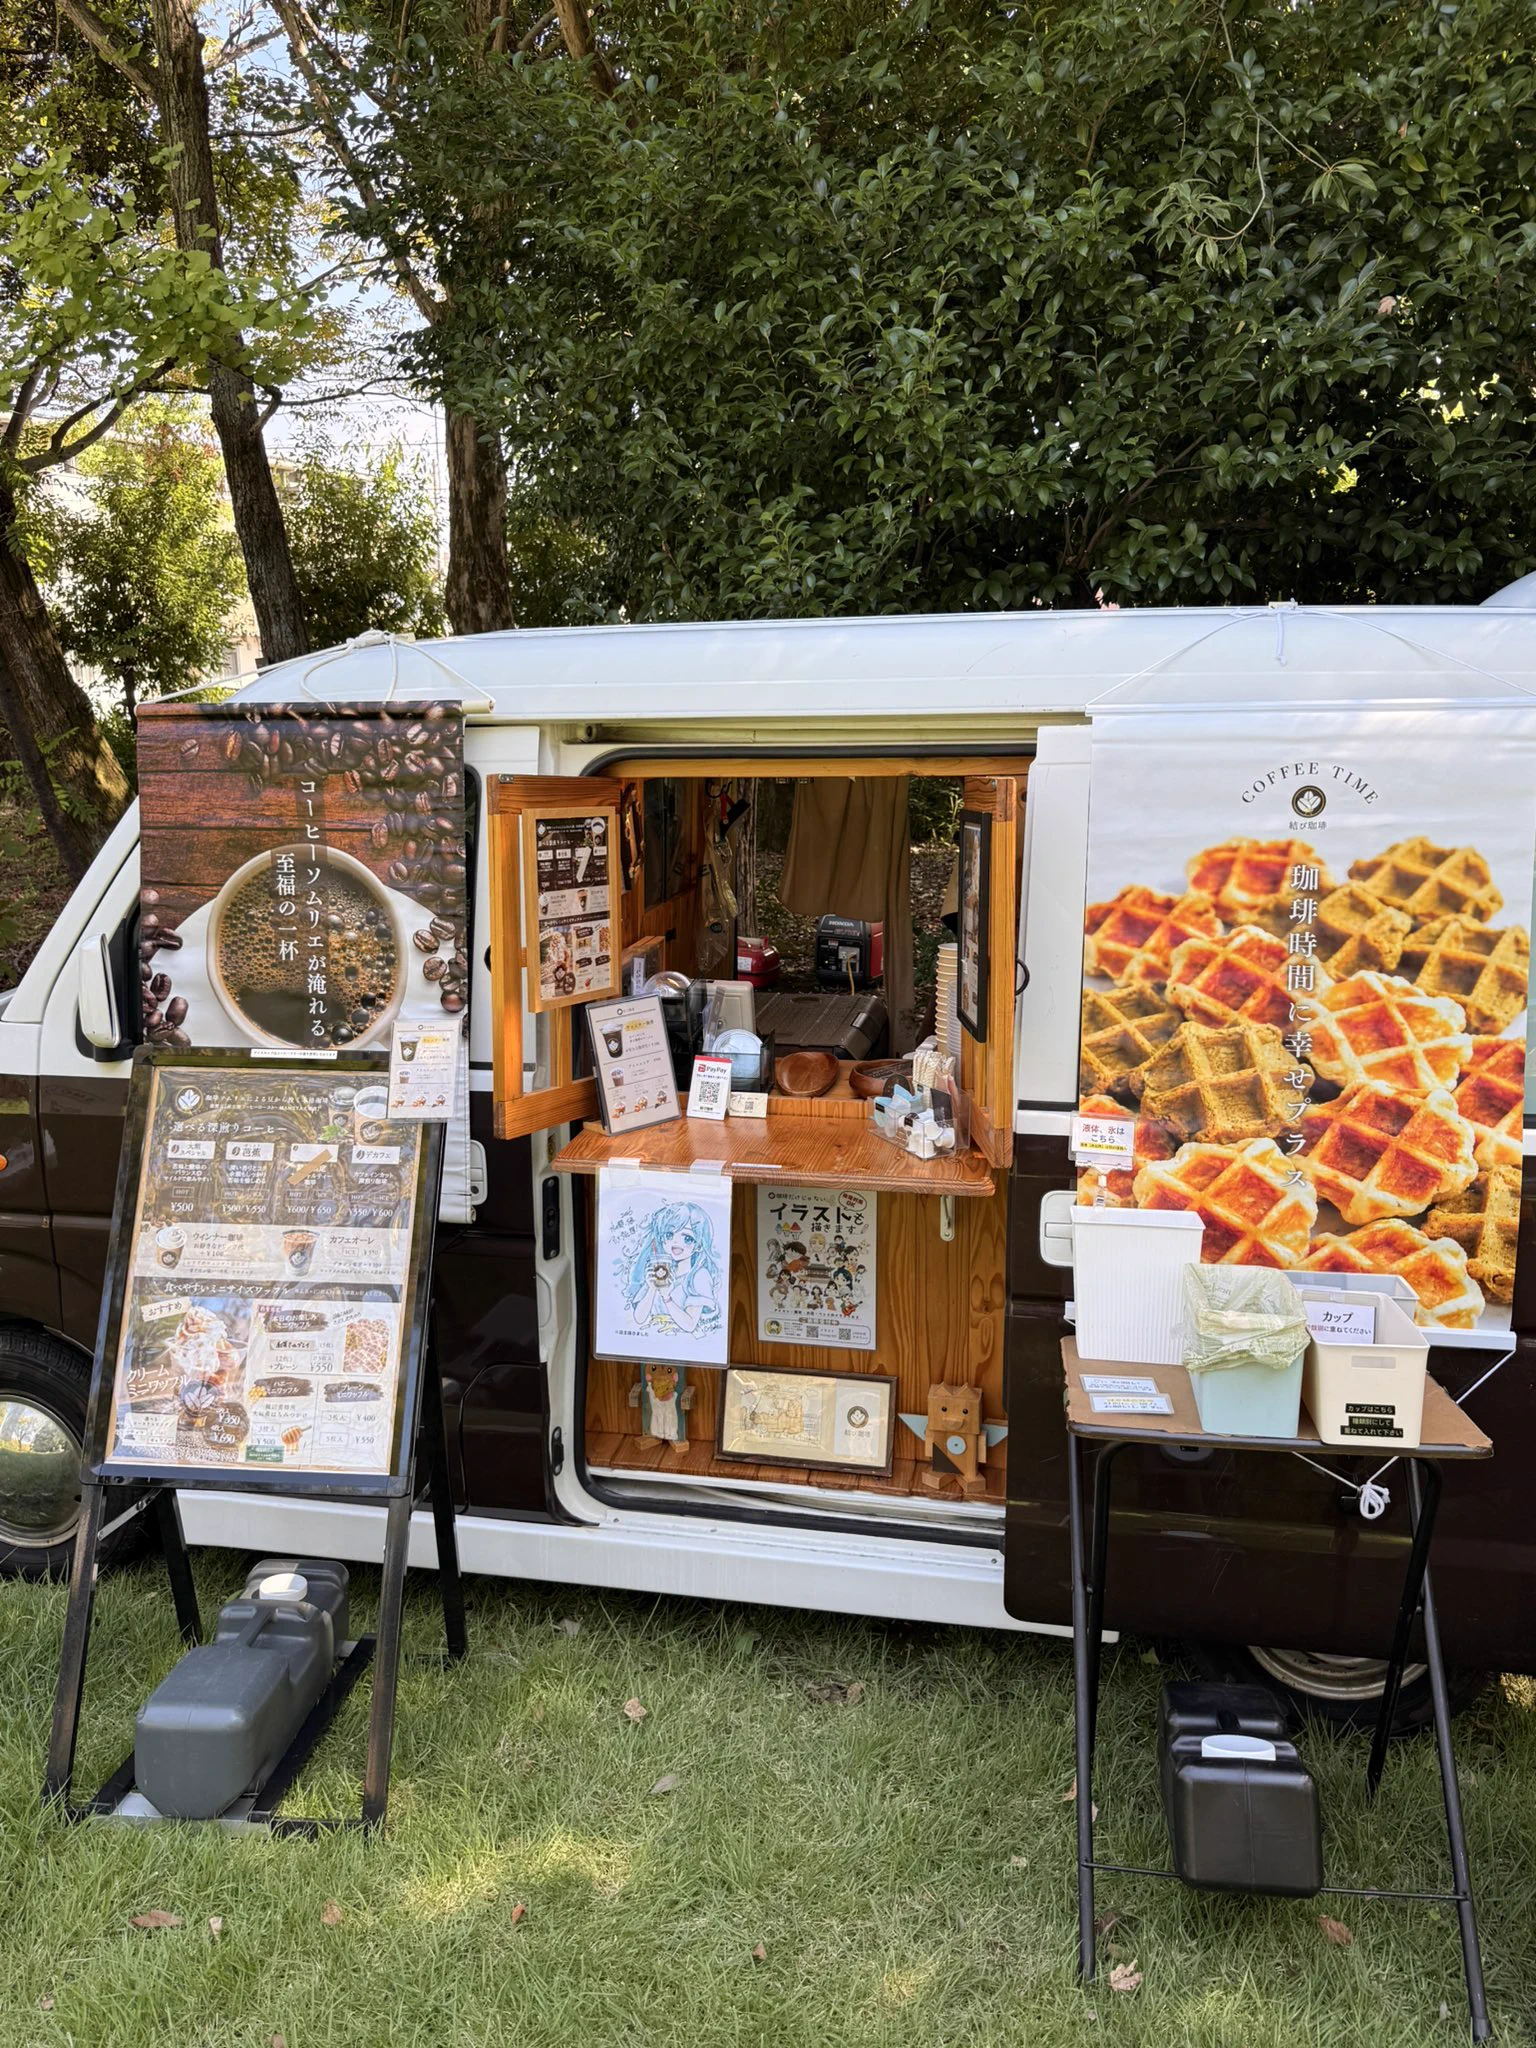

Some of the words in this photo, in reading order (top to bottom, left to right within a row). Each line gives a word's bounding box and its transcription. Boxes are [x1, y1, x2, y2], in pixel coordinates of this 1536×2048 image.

[1241, 762, 1319, 804] COFFEE
[1332, 765, 1379, 804] TIME
[1288, 821, 1327, 830] 結び珈琲
[275, 852, 299, 961] 至福の一杯
[301, 779, 327, 1037] コーヒーソムリエが淹れる
[828, 919, 854, 927] HONDA
[1281, 864, 1320, 1187] 珈琲時間に幸せプラス
[706, 1065, 727, 1074] PayPay
[1082, 1123, 1125, 1135] 液体、氷は
[1091, 1134, 1116, 1144] こちら
[365, 1150, 391, 1159] デカフェ
[148, 1301, 183, 1317] おすすめ
[1322, 1311, 1354, 1324] カップ
[310, 1362, 334, 1373] ¥550
[128, 1364, 170, 1384] クリーム
[127, 1375, 191, 1397] ミニワッフル
[1347, 1405, 1393, 1414] カップはこちら
[1352, 1417, 1391, 1426] 種類別にして
[1344, 1427, 1402, 1436] 重ねて入れて下さい
